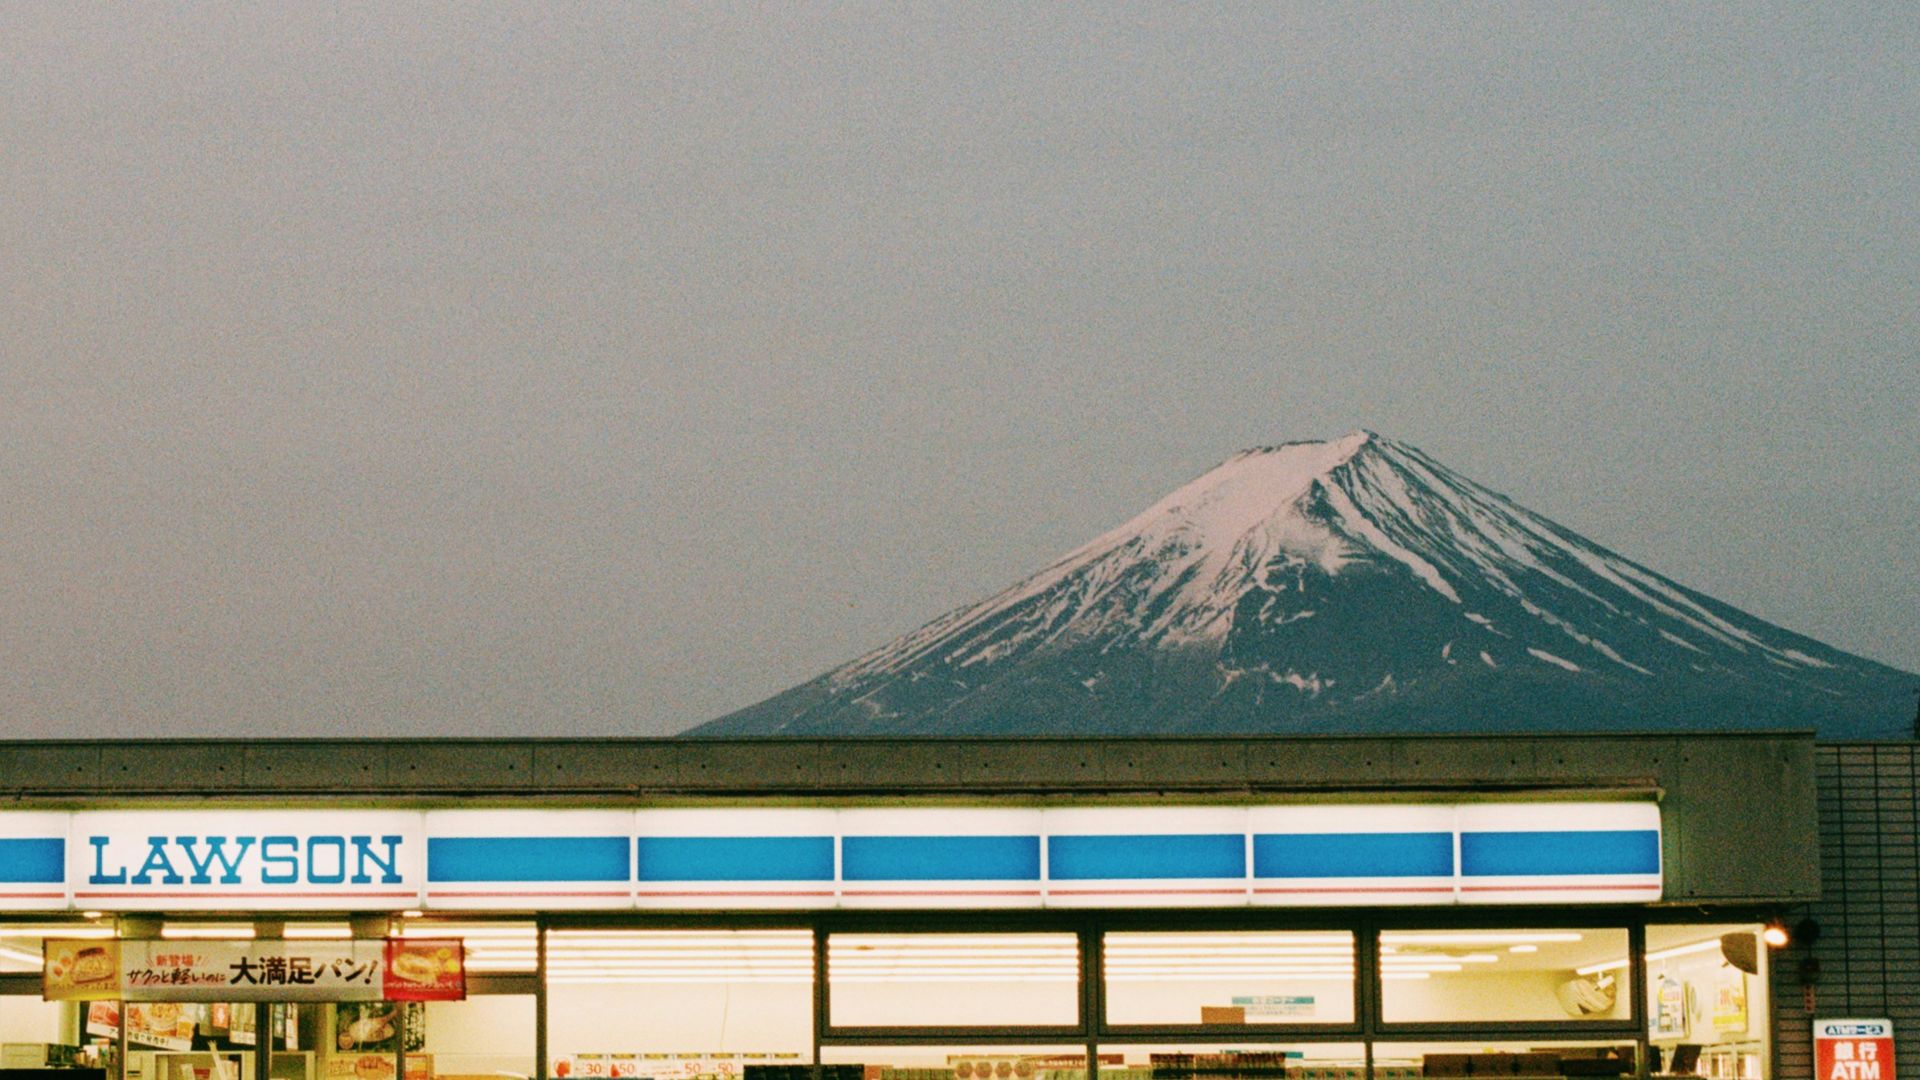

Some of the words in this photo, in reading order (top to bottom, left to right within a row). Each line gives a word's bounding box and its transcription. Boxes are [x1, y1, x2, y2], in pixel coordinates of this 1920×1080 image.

[89, 836, 402, 885] LAWSON
[230, 956, 378, 985] 大満足パン!
[1834, 1041, 1878, 1060] 銀行
[1831, 1060, 1880, 1080] ATM
